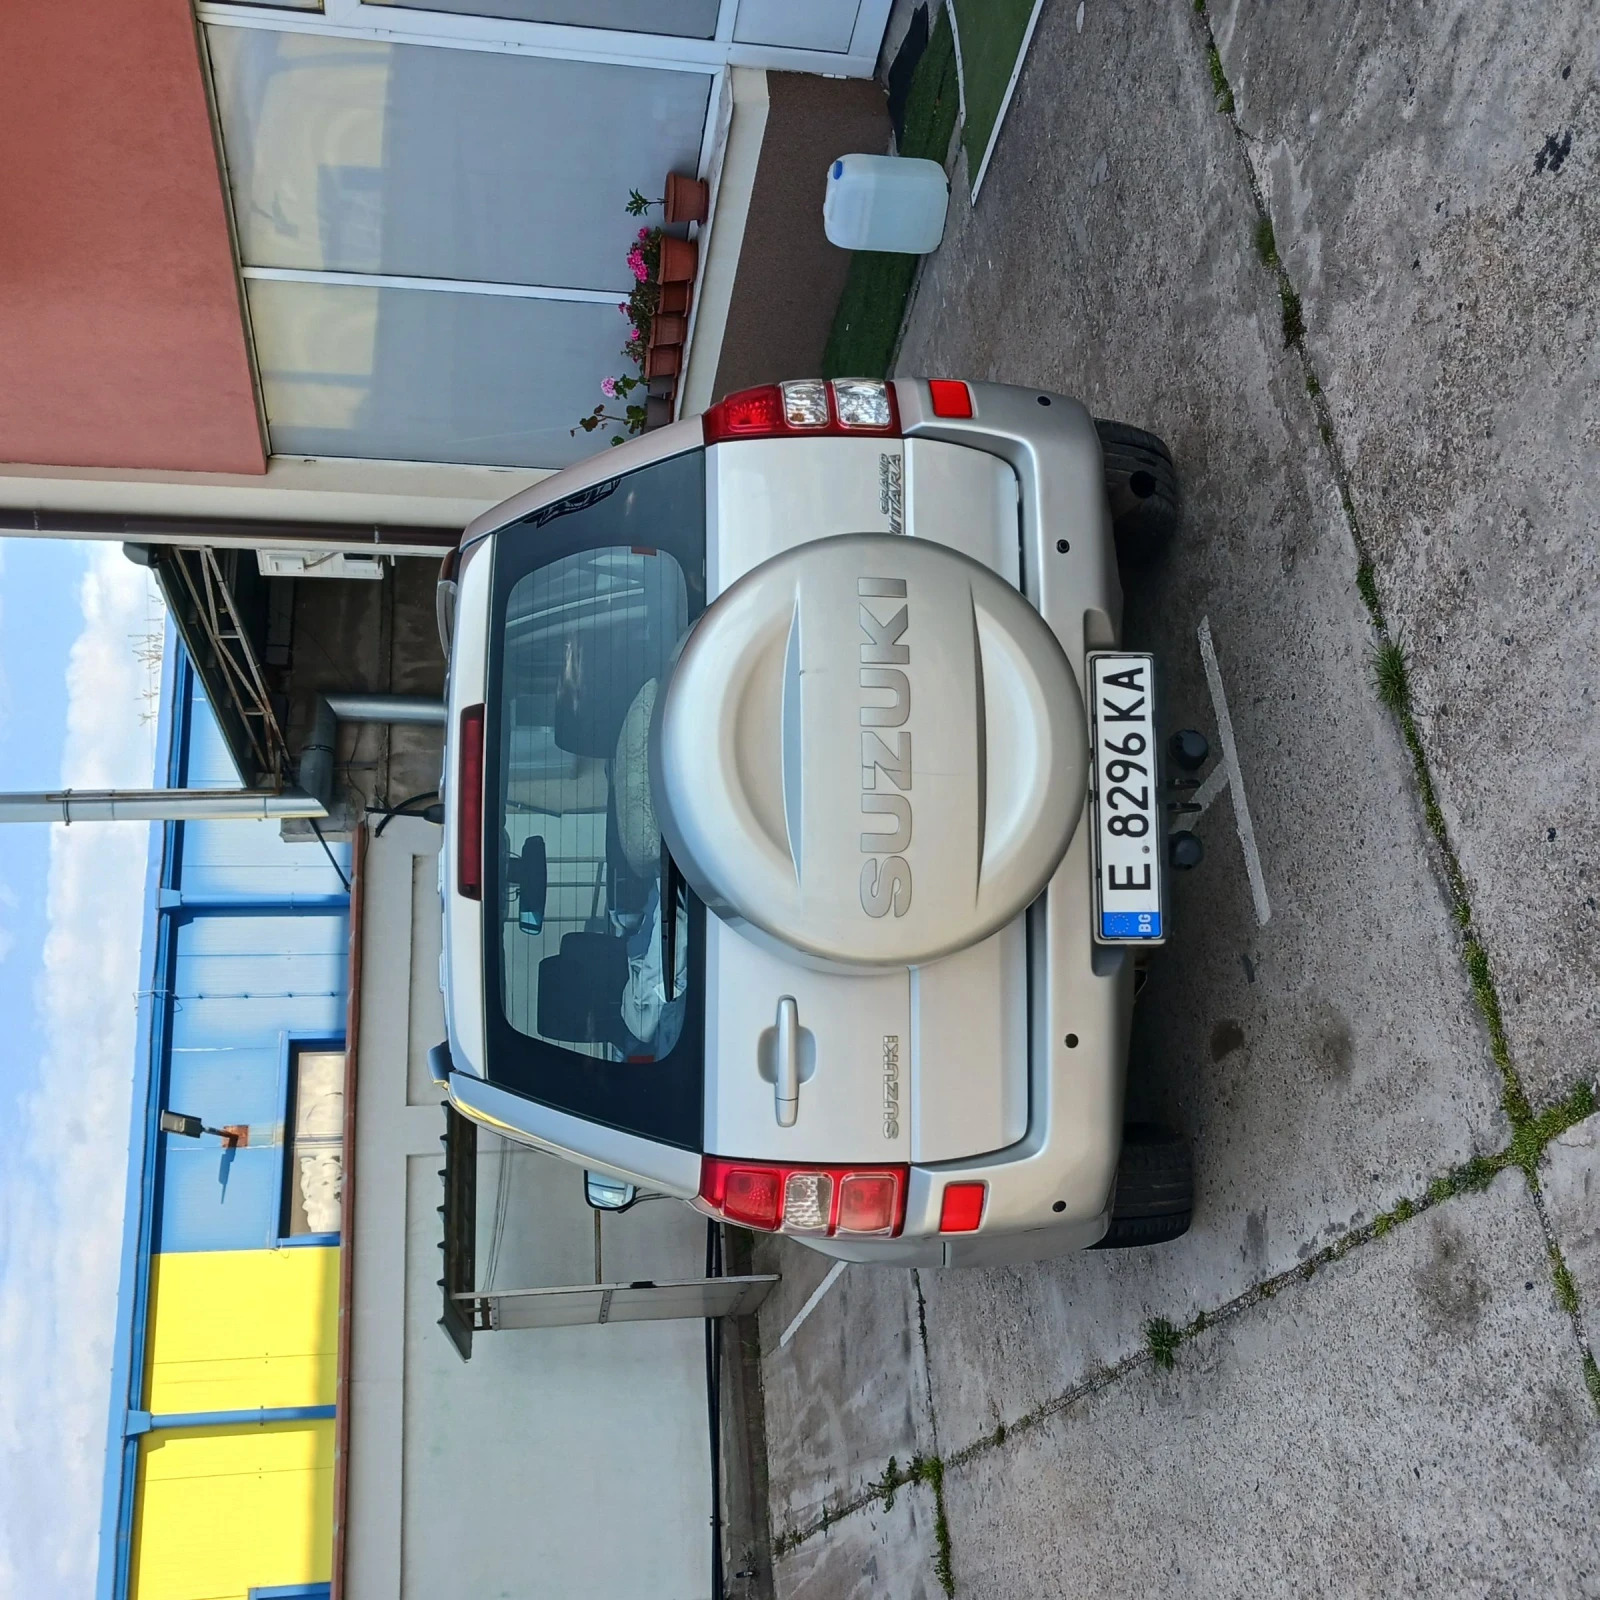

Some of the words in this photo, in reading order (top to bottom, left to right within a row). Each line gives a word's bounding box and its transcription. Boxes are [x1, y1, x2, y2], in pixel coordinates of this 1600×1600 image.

[879, 453, 889, 515] GRAND
[857, 577, 912, 918] SUZUKI
[1138, 913, 1152, 932] BG
[883, 1035, 899, 1139] SUZUKI
